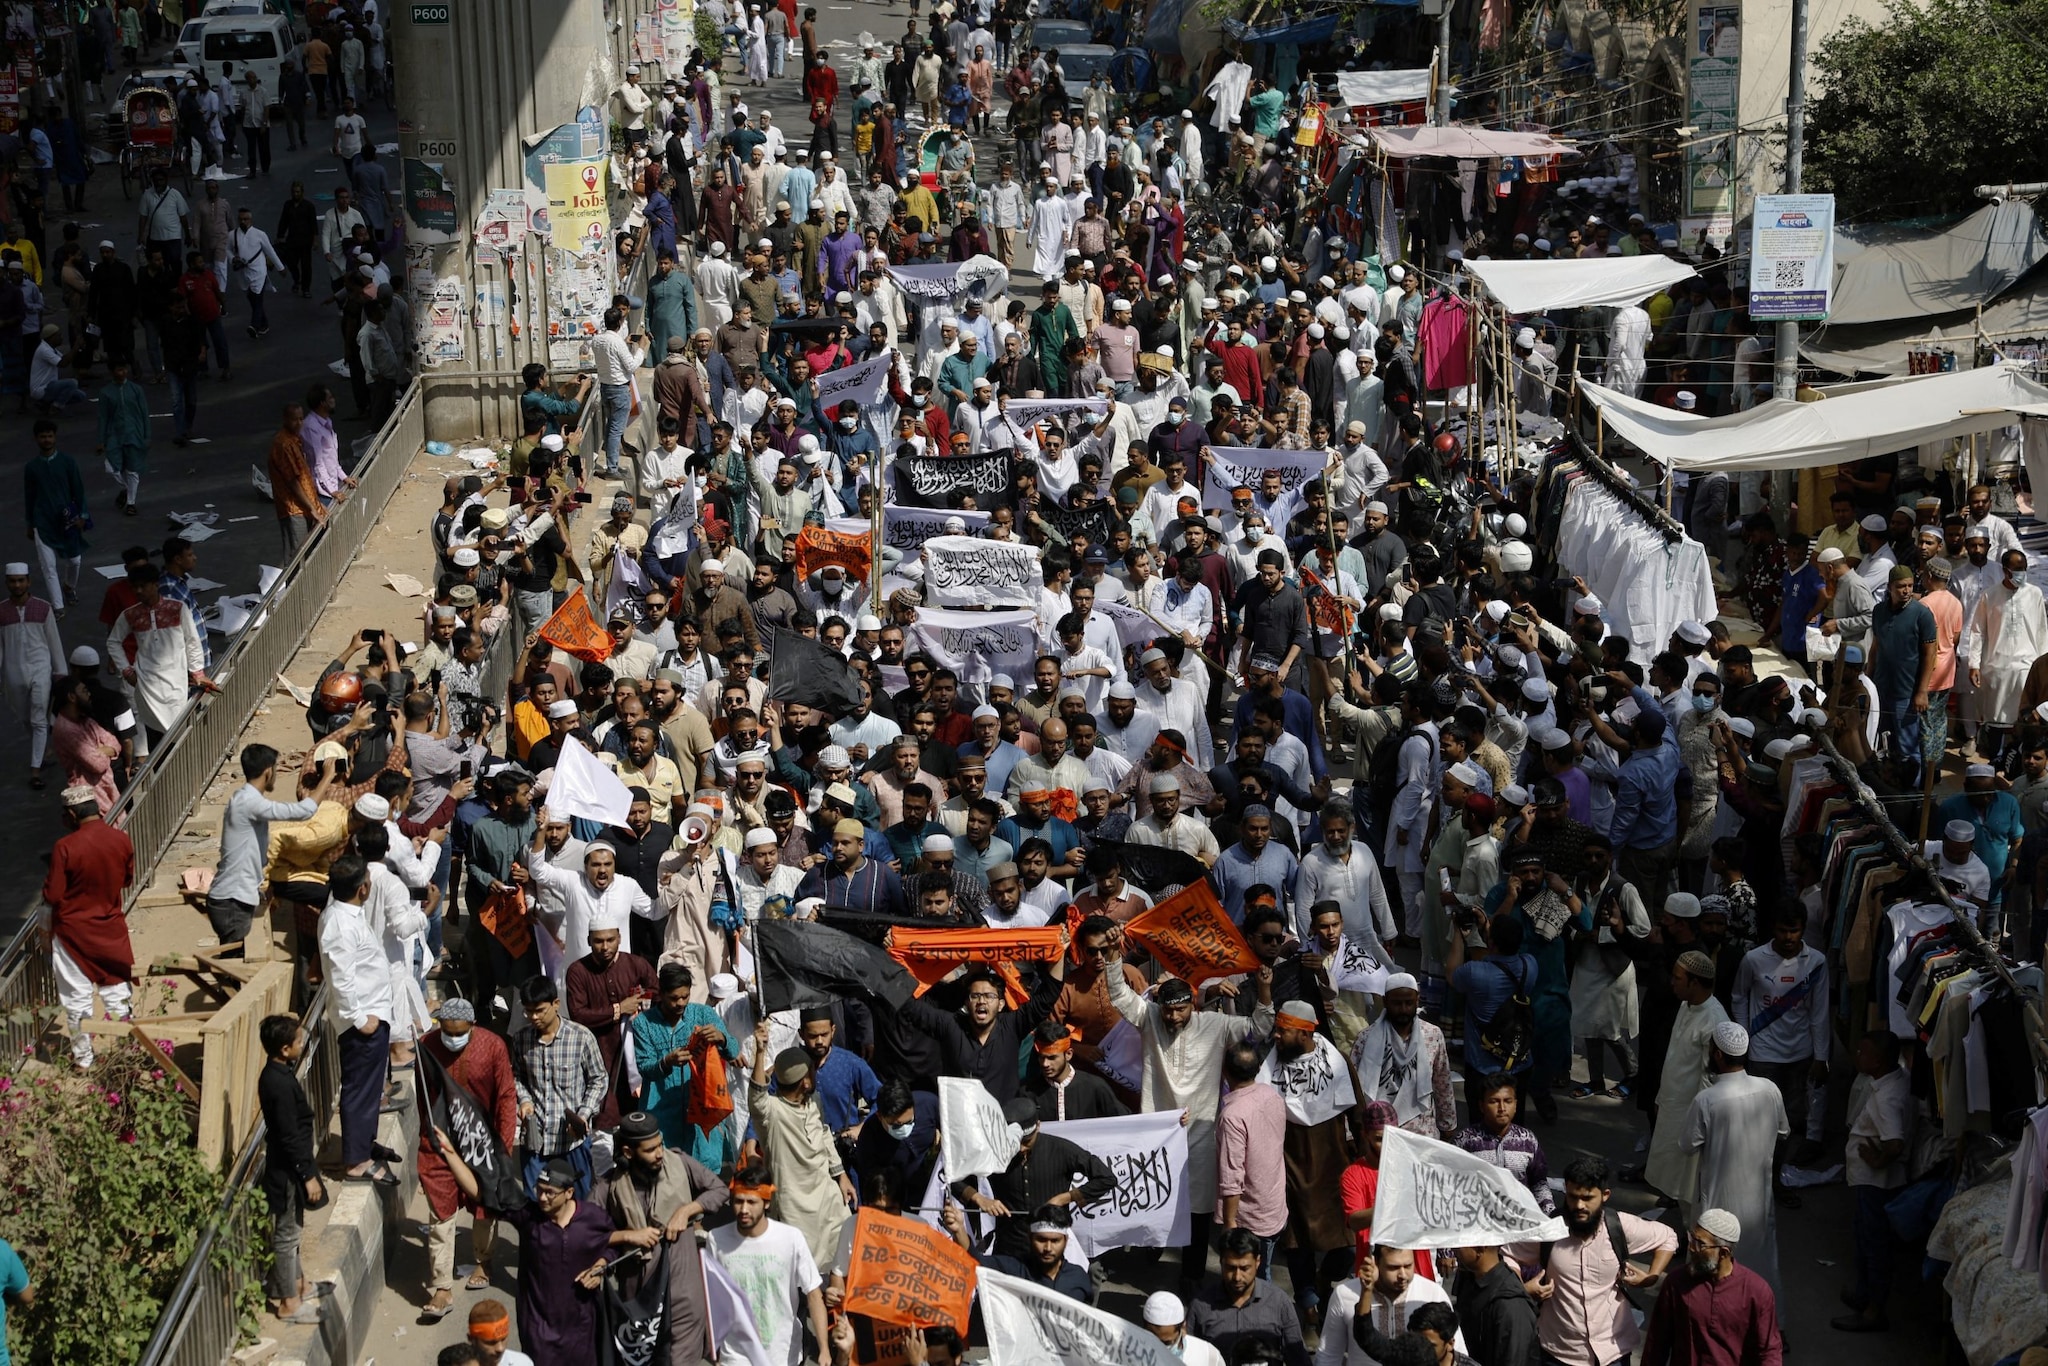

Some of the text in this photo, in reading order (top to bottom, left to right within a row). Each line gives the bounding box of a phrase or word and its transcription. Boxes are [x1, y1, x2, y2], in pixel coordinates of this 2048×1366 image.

[414, 8, 448, 20] P600
[419, 142, 456, 157] P600
[806, 529, 827, 541] 101
[1169, 915, 1191, 940] ONE
[1201, 907, 1240, 960] TO BUILD A
